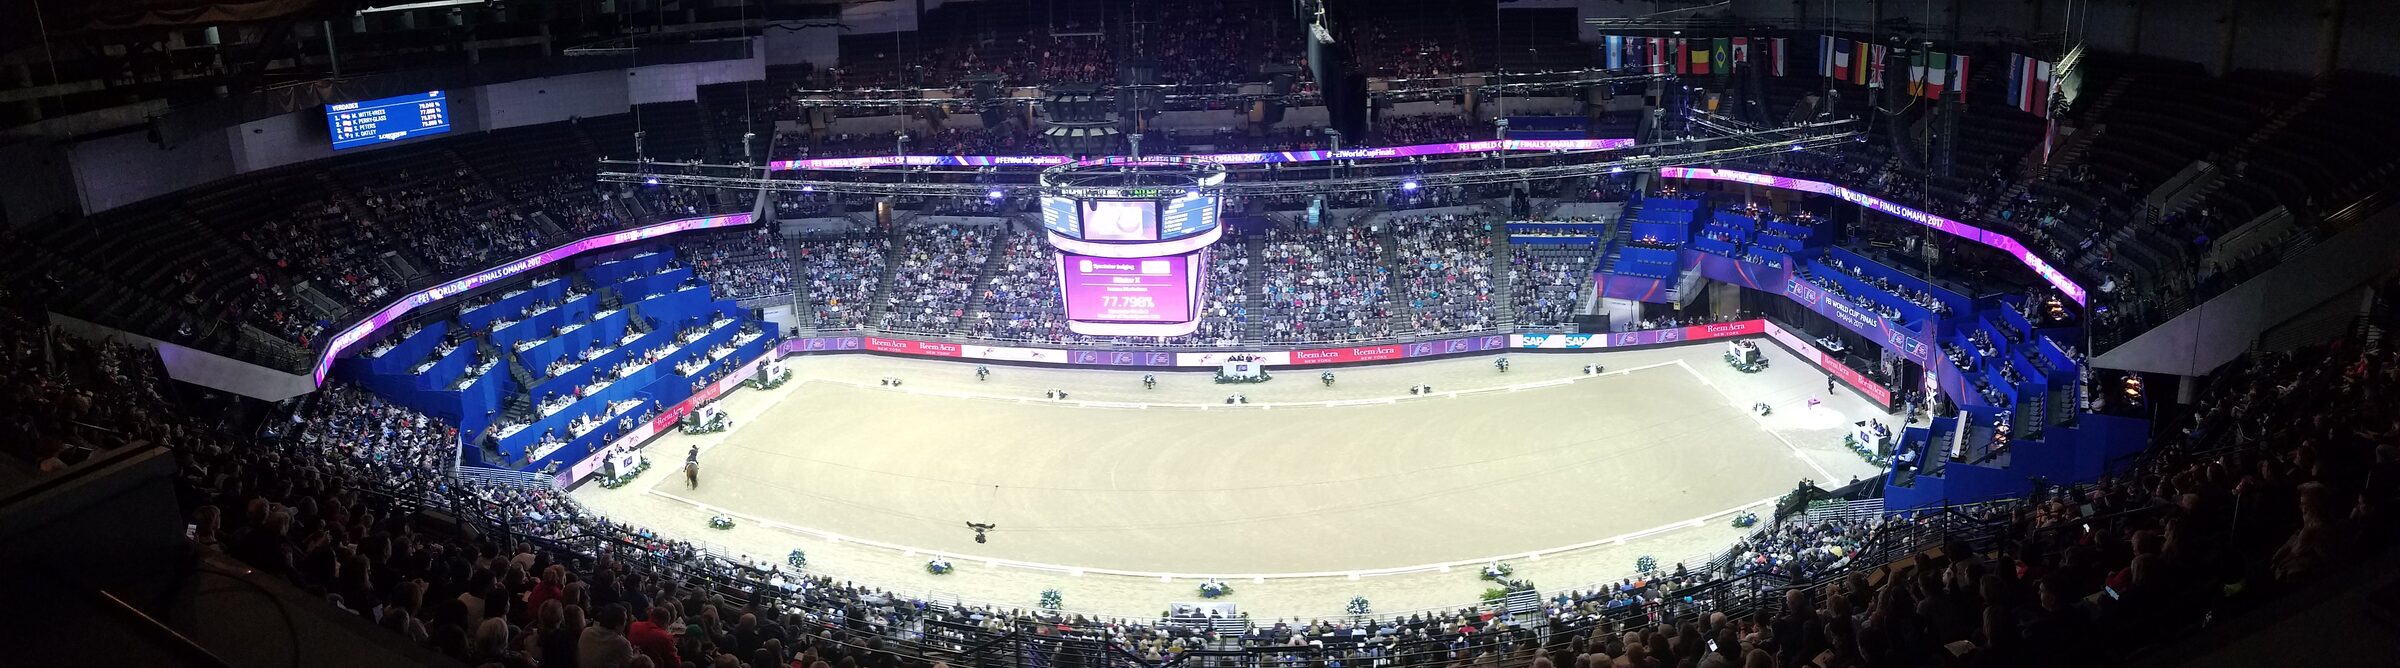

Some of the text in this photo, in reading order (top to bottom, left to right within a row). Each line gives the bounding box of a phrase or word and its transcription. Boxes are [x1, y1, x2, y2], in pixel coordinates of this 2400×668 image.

[1879, 201, 1901, 215] FINALS
[1901, 208, 1927, 225] OMAHA
[1927, 215, 1944, 228] 2017
[429, 283, 457, 301] WORLD
[479, 269, 502, 284] FINALS
[502, 262, 528, 277] OMAHA
[527, 256, 542, 267] 2017
[1832, 300, 1849, 313] WORLD
[1860, 313, 1878, 328] FINALS
[1836, 310, 1853, 325] OMAHA
[1707, 323, 1745, 333] Reem Acra
[871, 337, 907, 348] Reem Acra
[919, 341, 956, 352] Reem Acra
[1523, 336, 1545, 346] SAP
[1565, 336, 1588, 346] SAP
[1296, 350, 1338, 359] Reem Acra
[1353, 346, 1395, 356] Reem Acra
